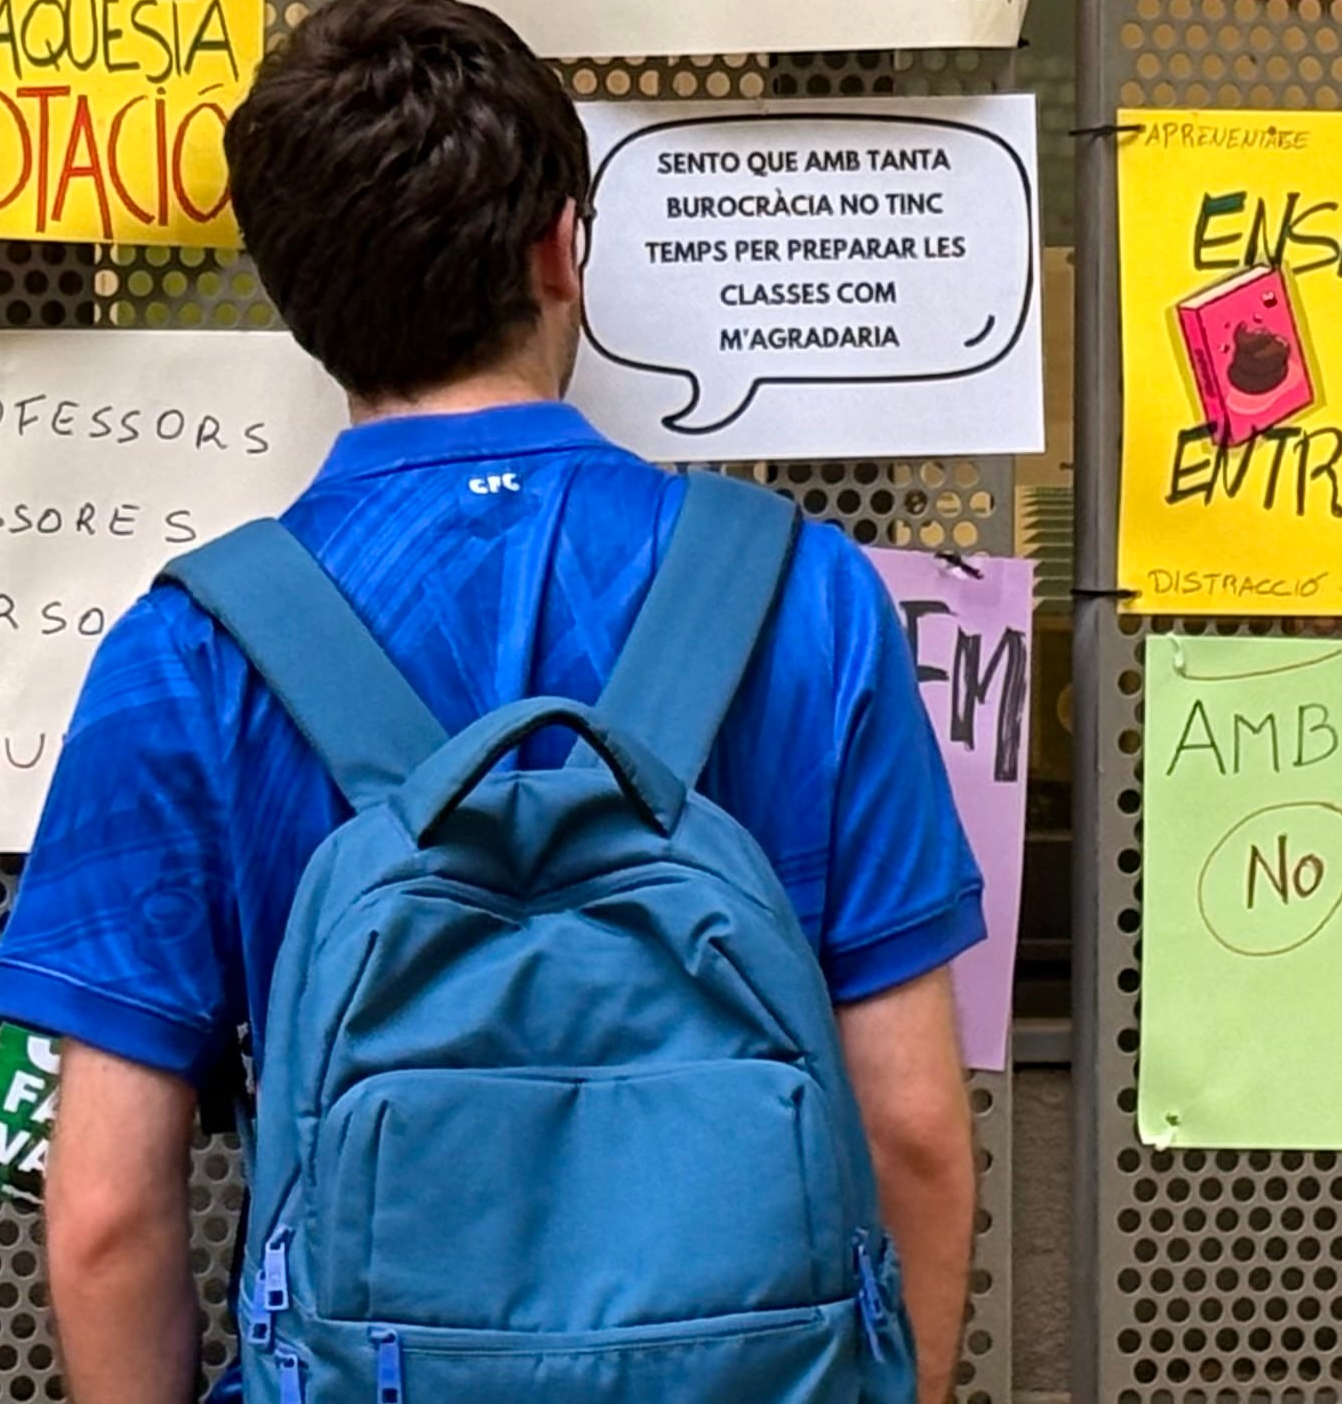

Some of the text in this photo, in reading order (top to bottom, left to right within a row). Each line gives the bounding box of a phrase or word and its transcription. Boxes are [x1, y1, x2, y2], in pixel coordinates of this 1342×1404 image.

[657, 149, 952, 176] SENTO QUE AMB TANTA
[667, 188, 944, 218] BUROCRÀCIA NO TINC
[645, 236, 966, 263] TEMPS PER PREPARAR LES
[720, 282, 896, 306] CLASSES COM
[720, 326, 900, 351] M'AGRADARIA
[1148, 568, 1329, 597] DISTRACCIÓ
[1166, 699, 1339, 776] AMB
